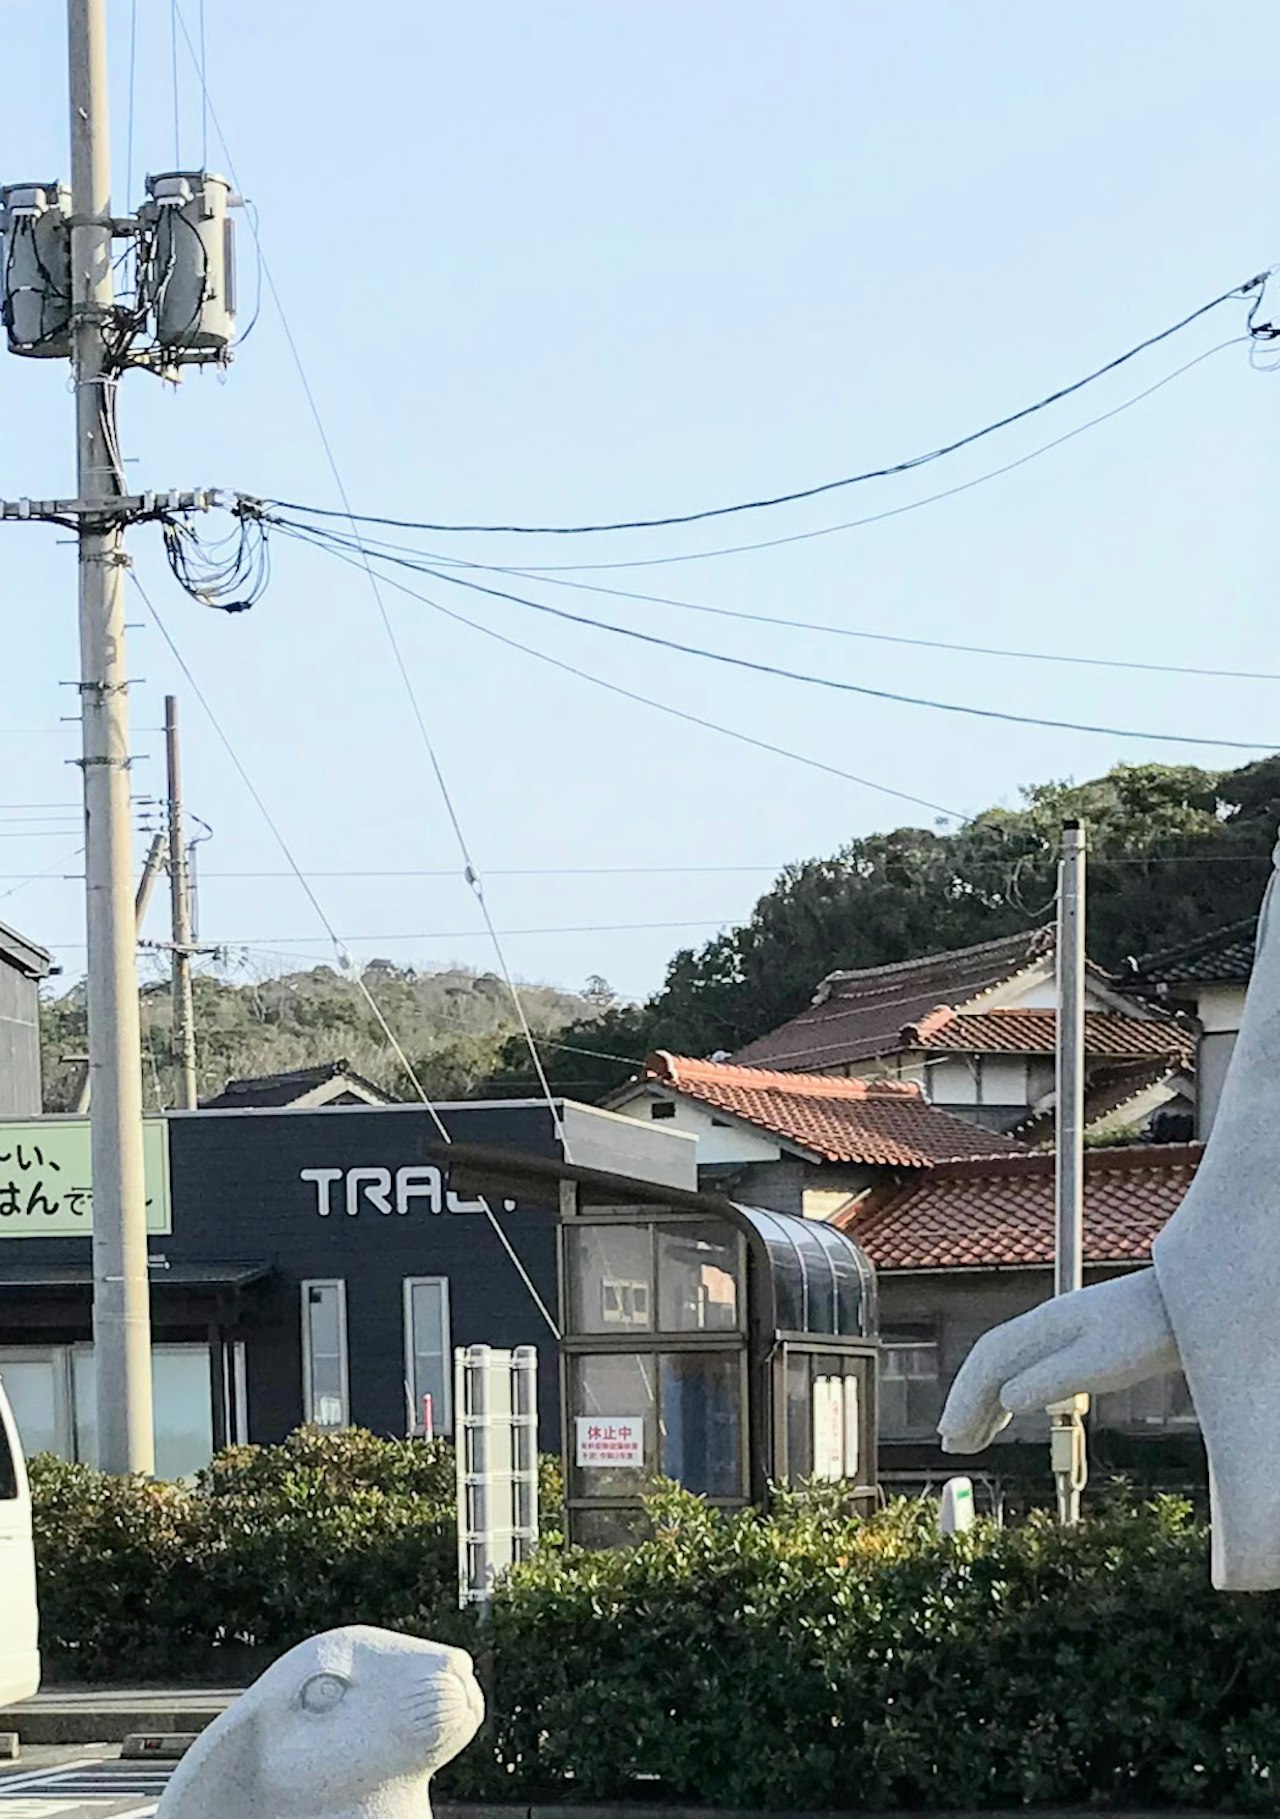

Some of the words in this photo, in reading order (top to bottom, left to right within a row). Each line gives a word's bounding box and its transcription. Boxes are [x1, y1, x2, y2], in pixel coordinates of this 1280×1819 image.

[299, 1164, 518, 1216] TRA
[587, 1425, 633, 1440] 休止中
